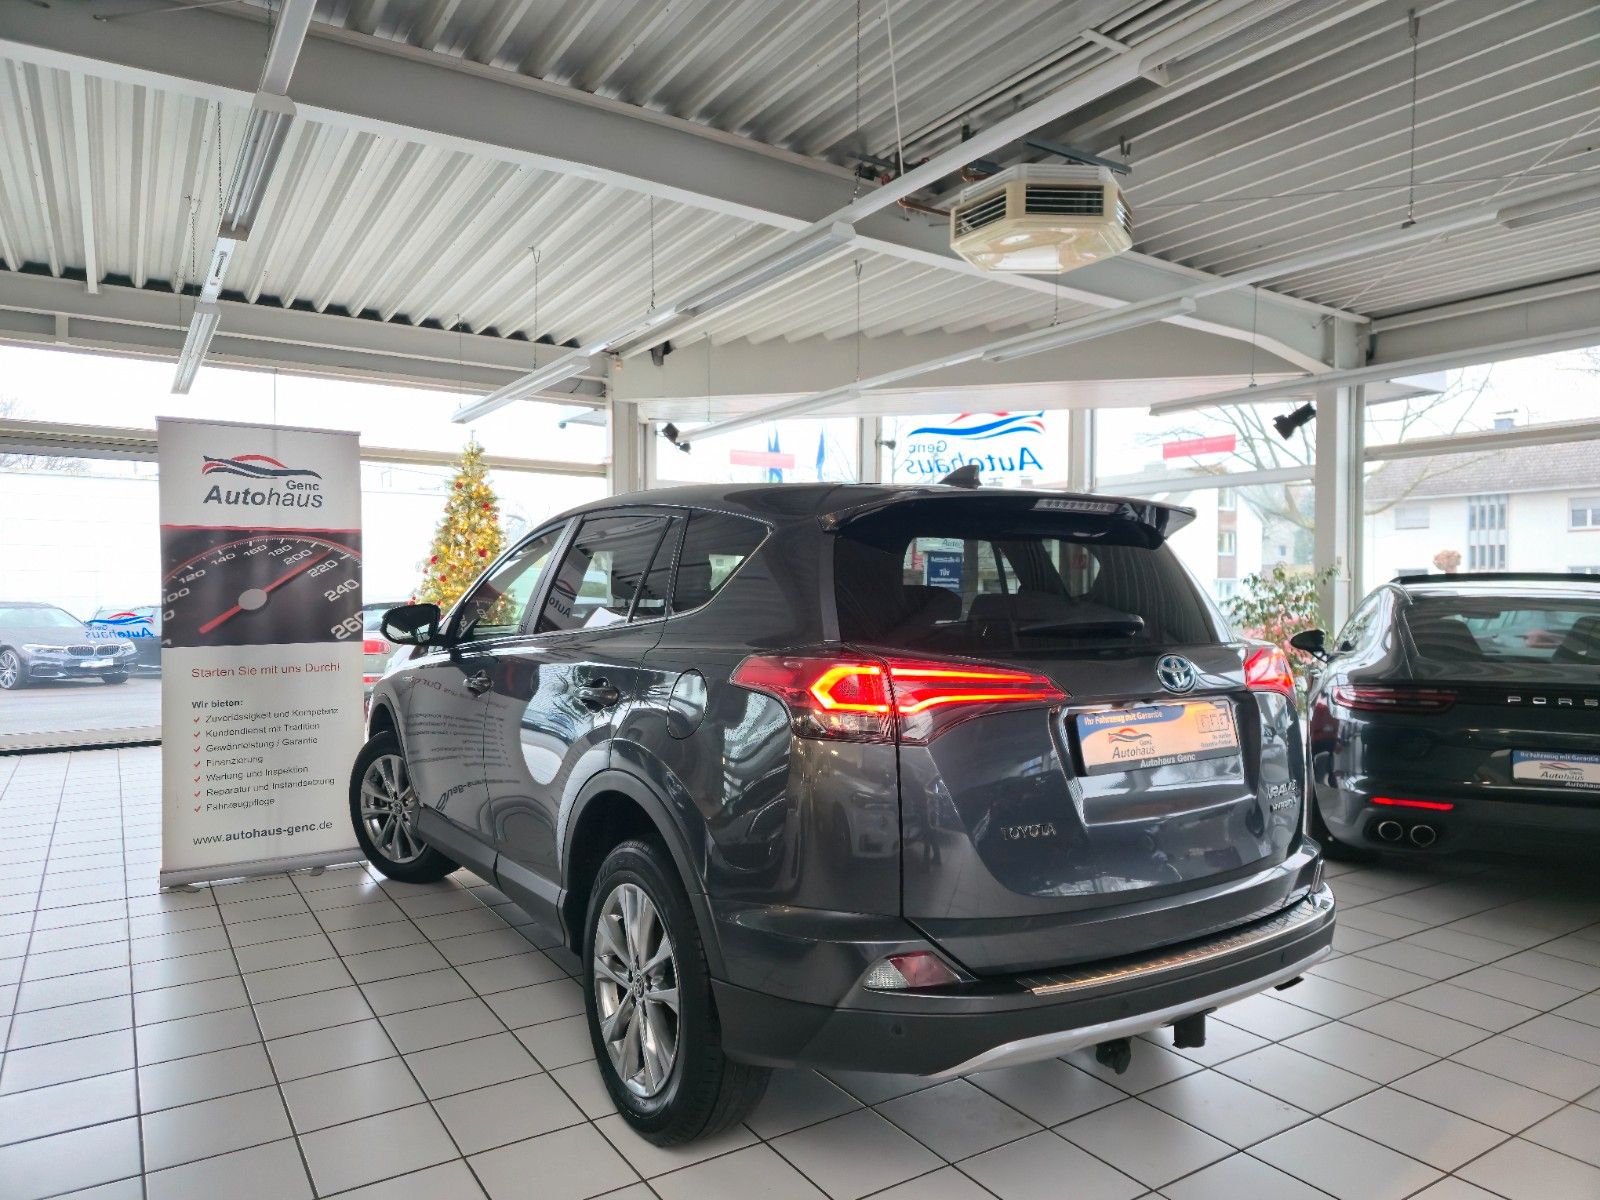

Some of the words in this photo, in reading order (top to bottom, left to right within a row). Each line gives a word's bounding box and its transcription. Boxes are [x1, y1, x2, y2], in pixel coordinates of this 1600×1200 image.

[286, 480, 319, 491] Genc
[203, 485, 323, 508] Autohaus
[211, 552, 236, 566] 140
[283, 549, 313, 565] 200
[178, 569, 206, 584] 120
[307, 560, 338, 578] 220
[323, 579, 360, 602] 240
[191, 667, 235, 678] Starten
[238, 666, 257, 676] Sie
[260, 664, 278, 675] mit
[281, 664, 301, 673] uns
[305, 662, 340, 673] Durch!
[191, 700, 208, 709] Wir
[211, 699, 243, 708] bieten:
[205, 726, 267, 738] Kundendienst
[284, 722, 320, 732] Tradition
[282, 737, 318, 746] Garantie
[206, 755, 264, 767] Finanzierung
[1112, 746, 1156, 760] Autohaus
[1140, 756, 1176, 769] Autohaus
[1177, 753, 1196, 763] Genc
[206, 771, 244, 782] Wartung
[246, 770, 263, 778] und
[265, 766, 309, 777] Inspektion
[1540, 771, 1585, 781] Autohaus
[206, 785, 251, 797] Reparatur
[253, 784, 269, 792] und
[192, 820, 333, 846] www.autohaus-genc.de
[1001, 822, 1056, 840] TOYOTA
